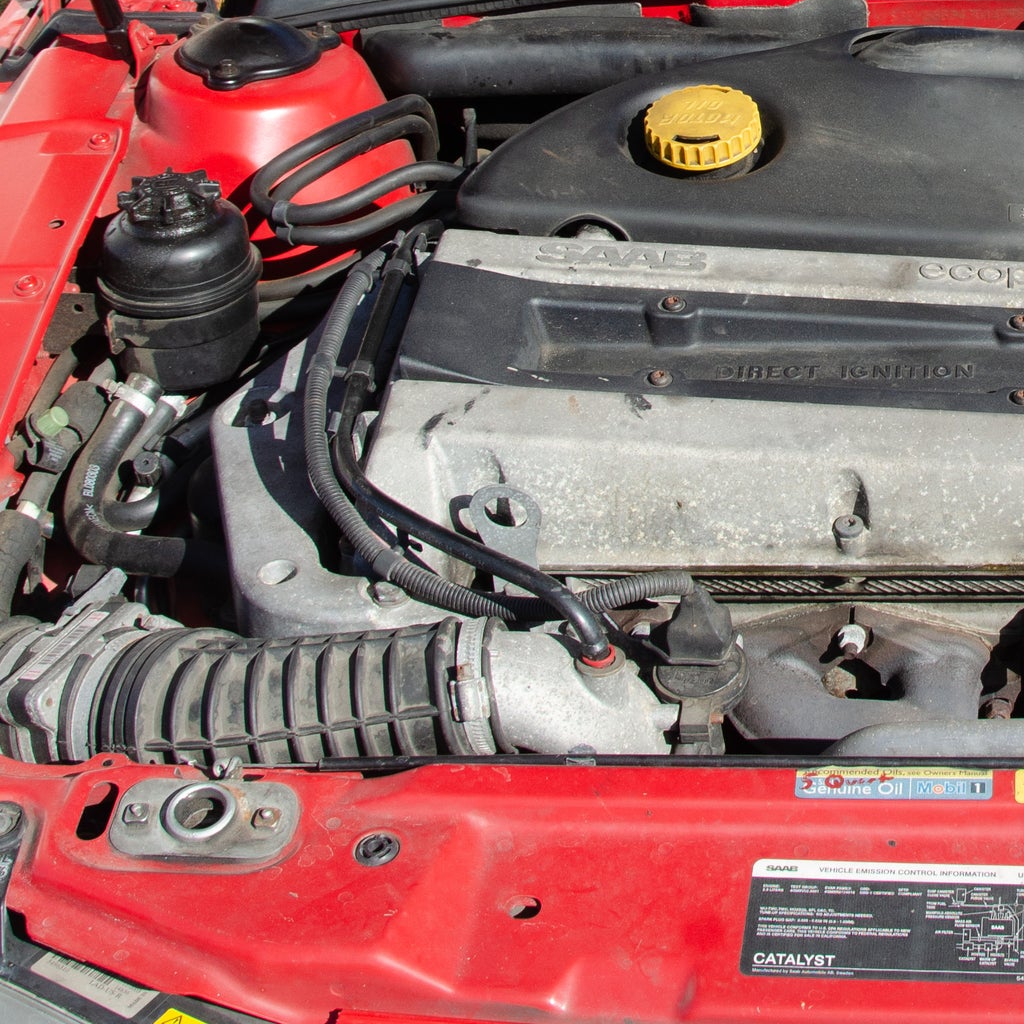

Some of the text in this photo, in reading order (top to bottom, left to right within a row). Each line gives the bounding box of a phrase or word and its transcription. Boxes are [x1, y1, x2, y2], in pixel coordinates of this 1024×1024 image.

[535, 241, 708, 272] SAAB
[715, 363, 976, 380] DIRECT IGNITION
[803, 782, 903, 795] Genuine Oil
[917, 780, 967, 794] Mobil
[766, 864, 798, 872] SAAB
[819, 866, 854, 874] VEHICLE
[898, 869, 937, 877] CONTROL
[940, 870, 997, 878] INFORMATION
[752, 951, 837, 966] CATALYST
